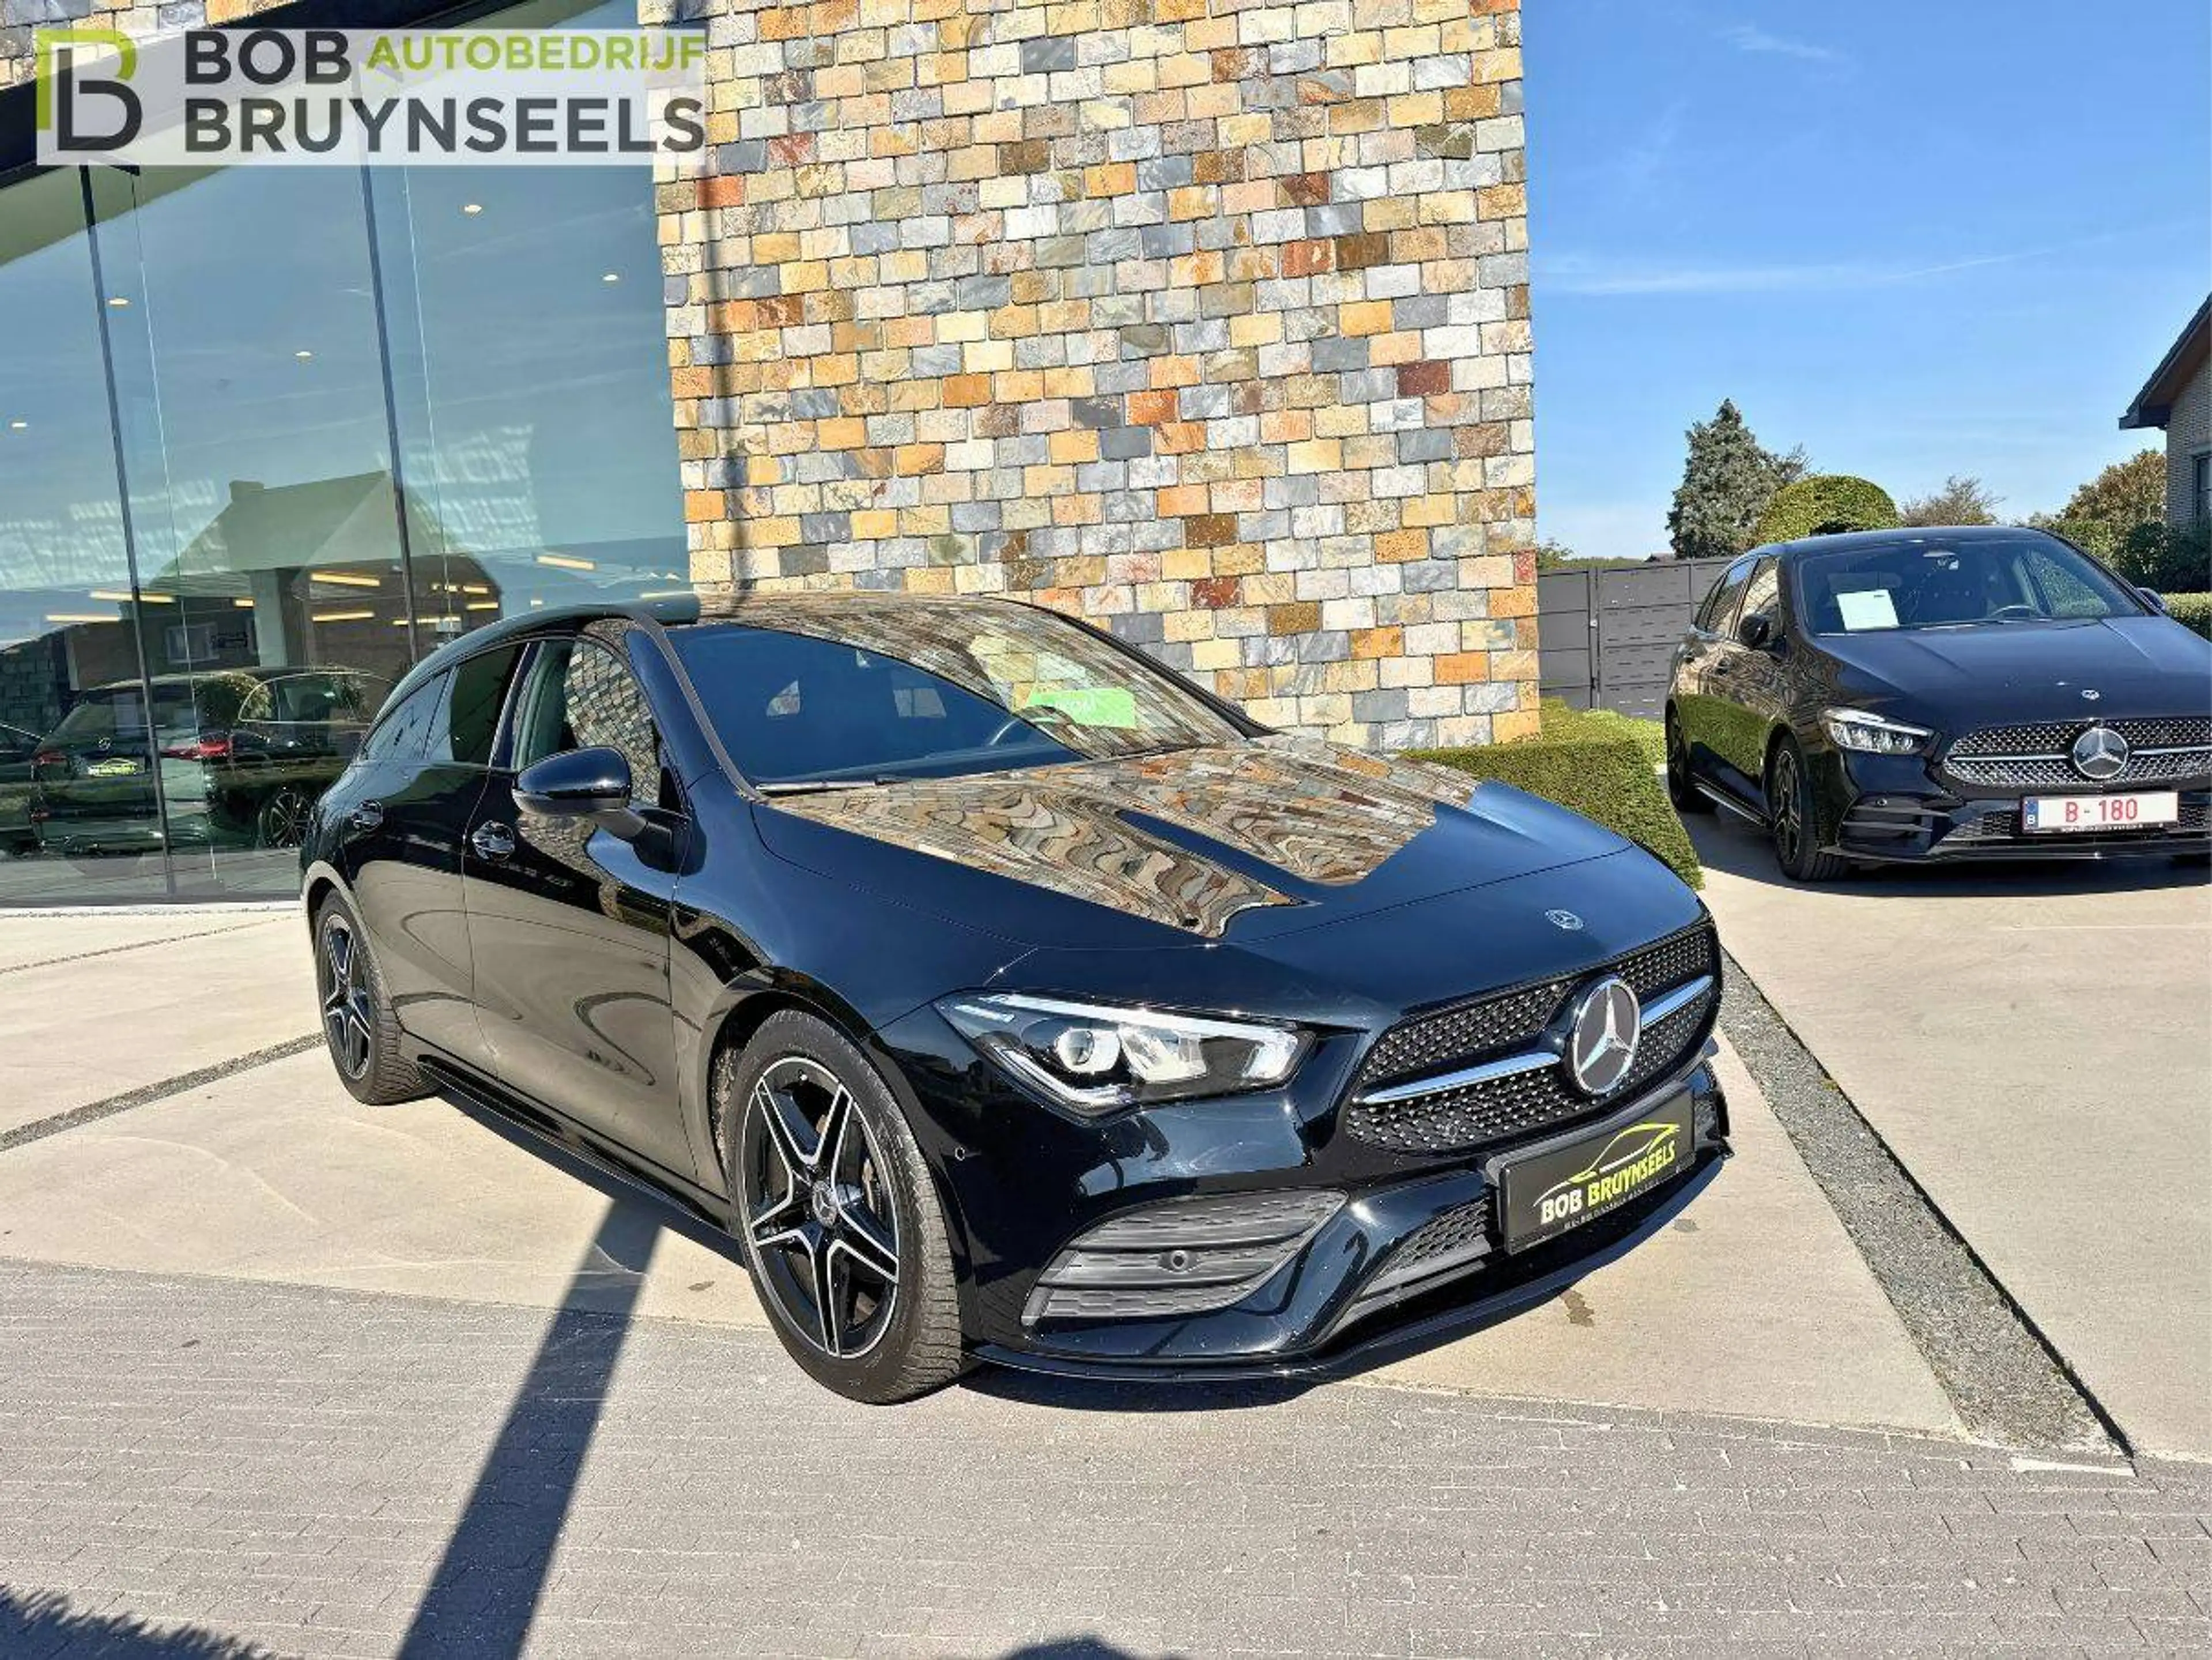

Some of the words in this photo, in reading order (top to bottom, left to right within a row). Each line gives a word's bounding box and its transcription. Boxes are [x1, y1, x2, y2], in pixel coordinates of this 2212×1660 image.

[2027, 814, 2036, 825] B
[1541, 1189, 1582, 1224] BOB
[1587, 1140, 1675, 1207] BRUYNSEELS
